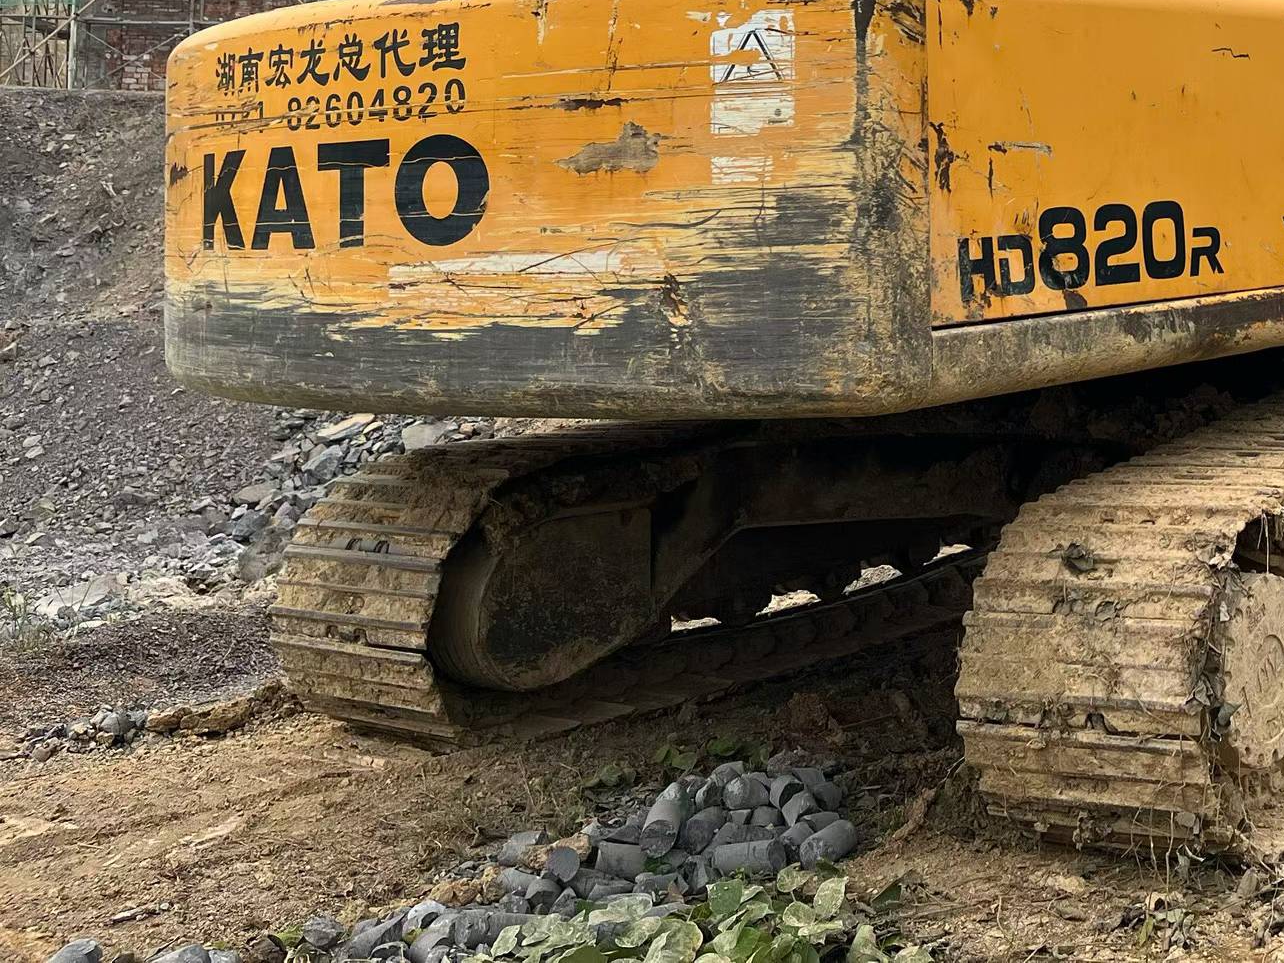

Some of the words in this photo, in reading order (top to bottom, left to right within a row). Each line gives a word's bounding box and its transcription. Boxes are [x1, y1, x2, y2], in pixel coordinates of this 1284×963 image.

[216, 22, 466, 95] 湖南宏龙总代理
[287, 78, 466, 132] 82604820
[203, 134, 490, 251] KATO
[958, 200, 1225, 303] HD820R
